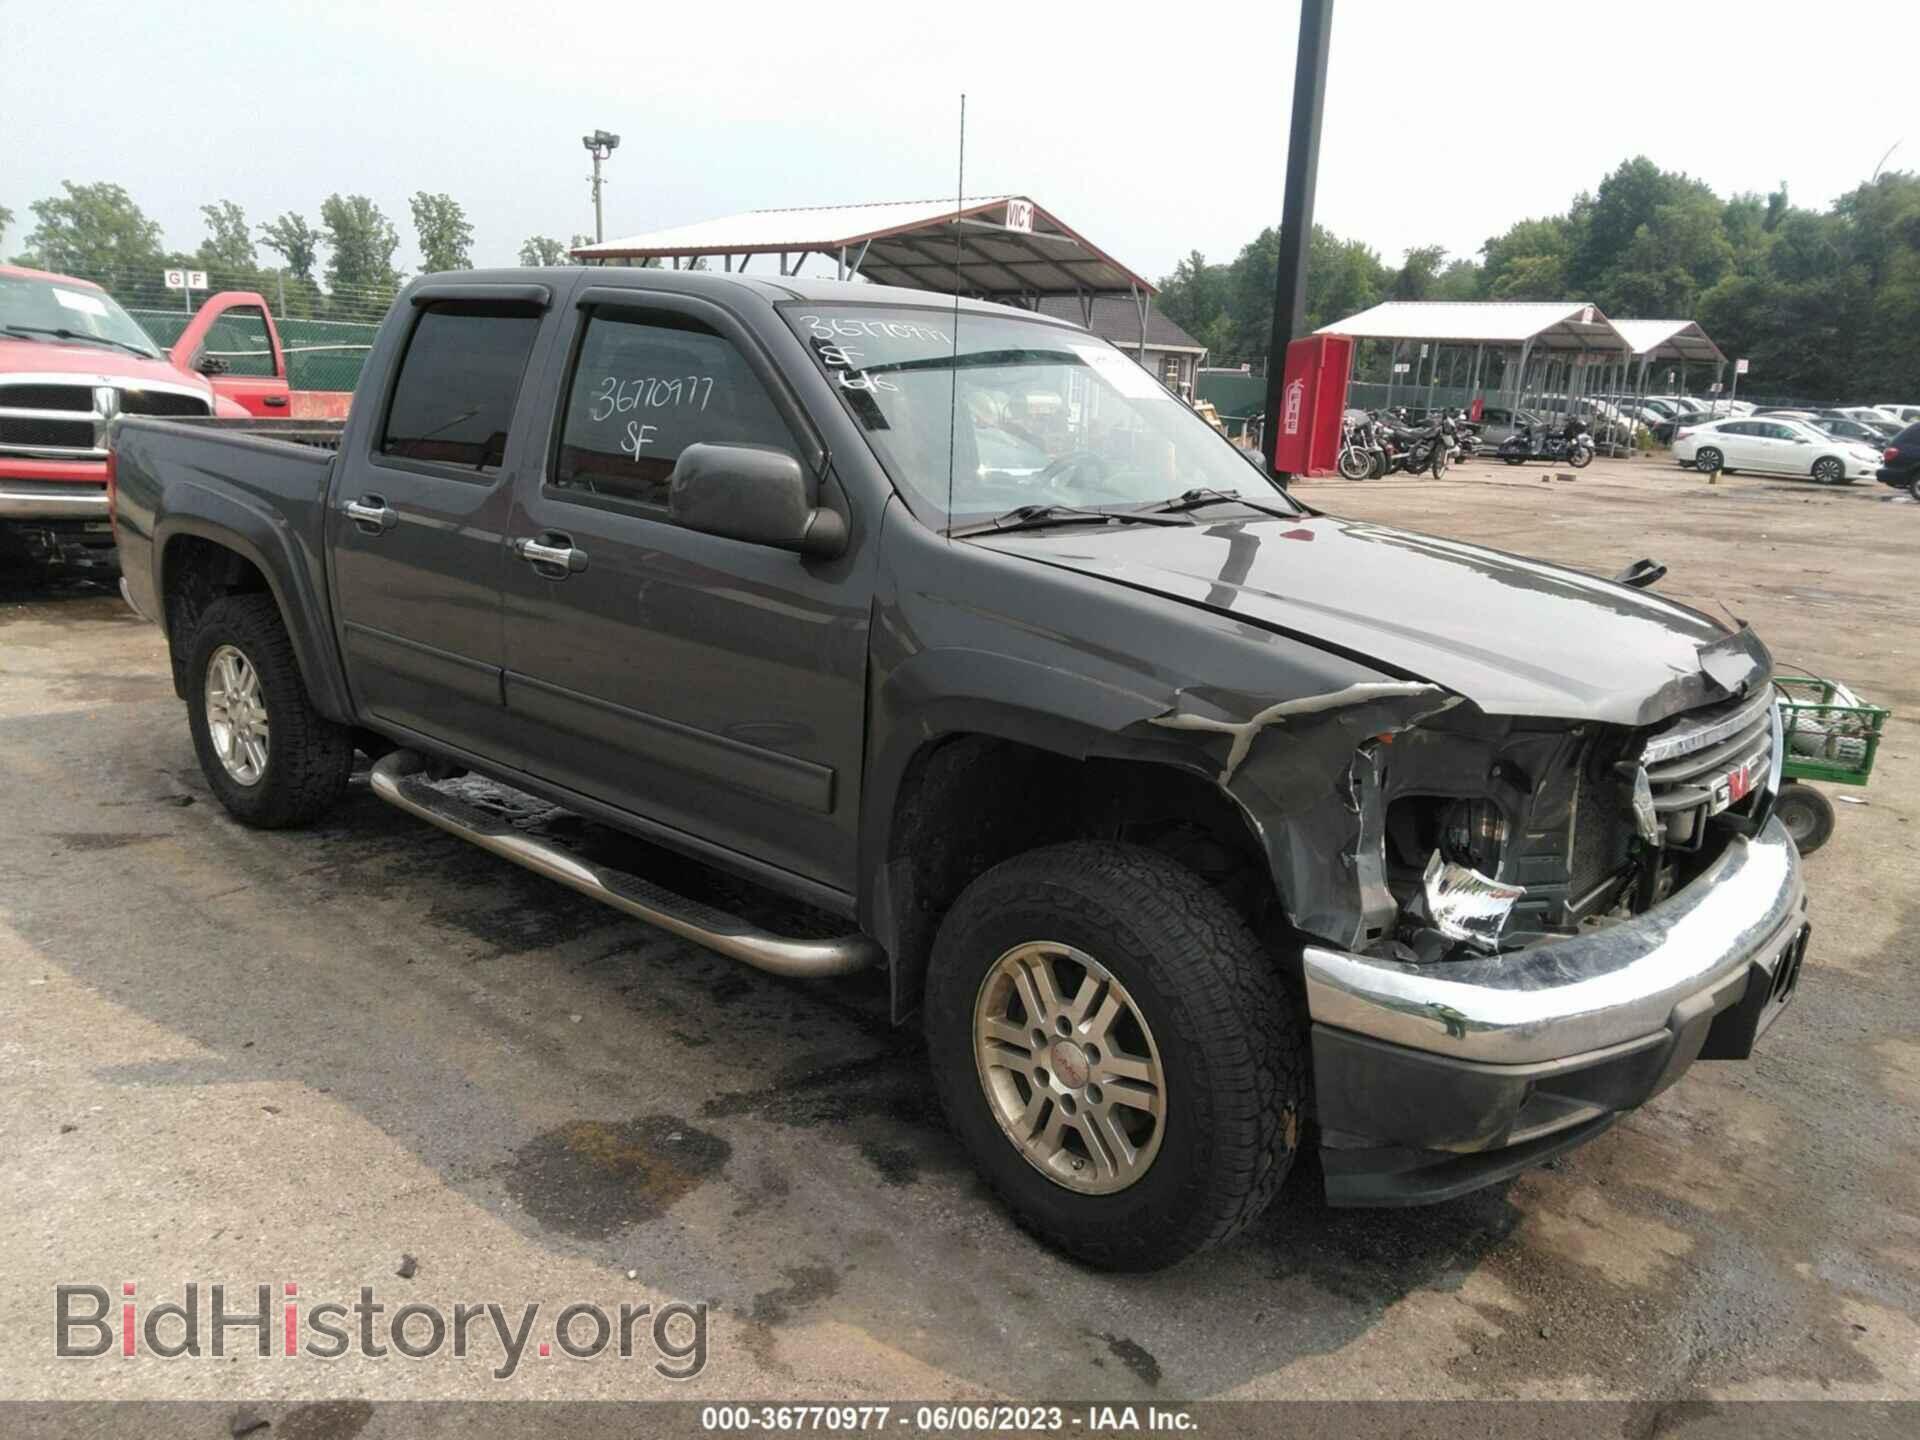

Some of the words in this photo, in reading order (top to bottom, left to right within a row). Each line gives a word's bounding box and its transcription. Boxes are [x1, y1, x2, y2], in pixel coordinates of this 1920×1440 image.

[1008, 202, 1025, 228] VIC
[1027, 206, 1033, 229] 1
[168, 271, 181, 285] G
[192, 273, 202, 285] F
[818, 345, 865, 365] SF
[593, 376, 714, 421] 36770977
[620, 420, 658, 462] SF
